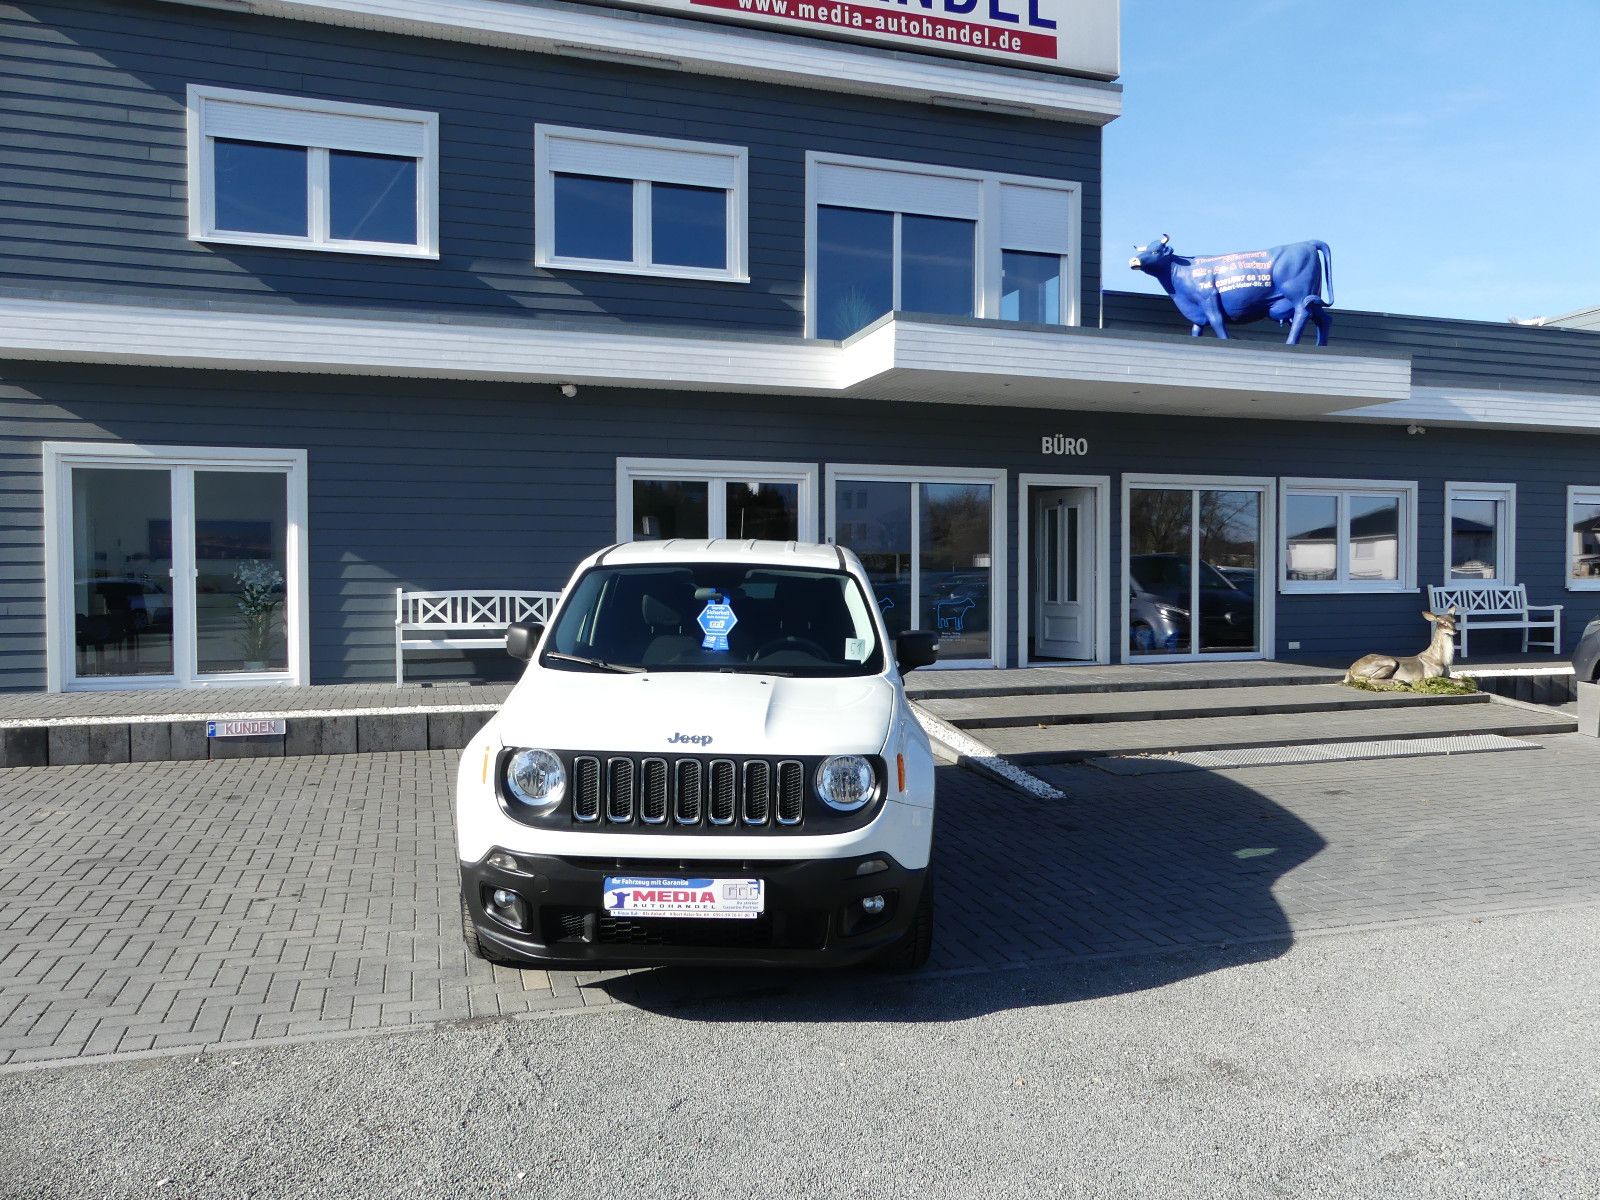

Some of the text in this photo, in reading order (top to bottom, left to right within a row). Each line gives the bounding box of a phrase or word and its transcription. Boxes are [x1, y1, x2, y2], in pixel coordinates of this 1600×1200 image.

[738, 0, 1021, 51] www.media-autohandel.de
[1041, 433, 1088, 456] BÜRO
[224, 721, 276, 735] KUNDEN
[667, 731, 713, 747] Jeep
[621, 878, 650, 886] Fahrzeug
[632, 890, 716, 903] MEDIA
